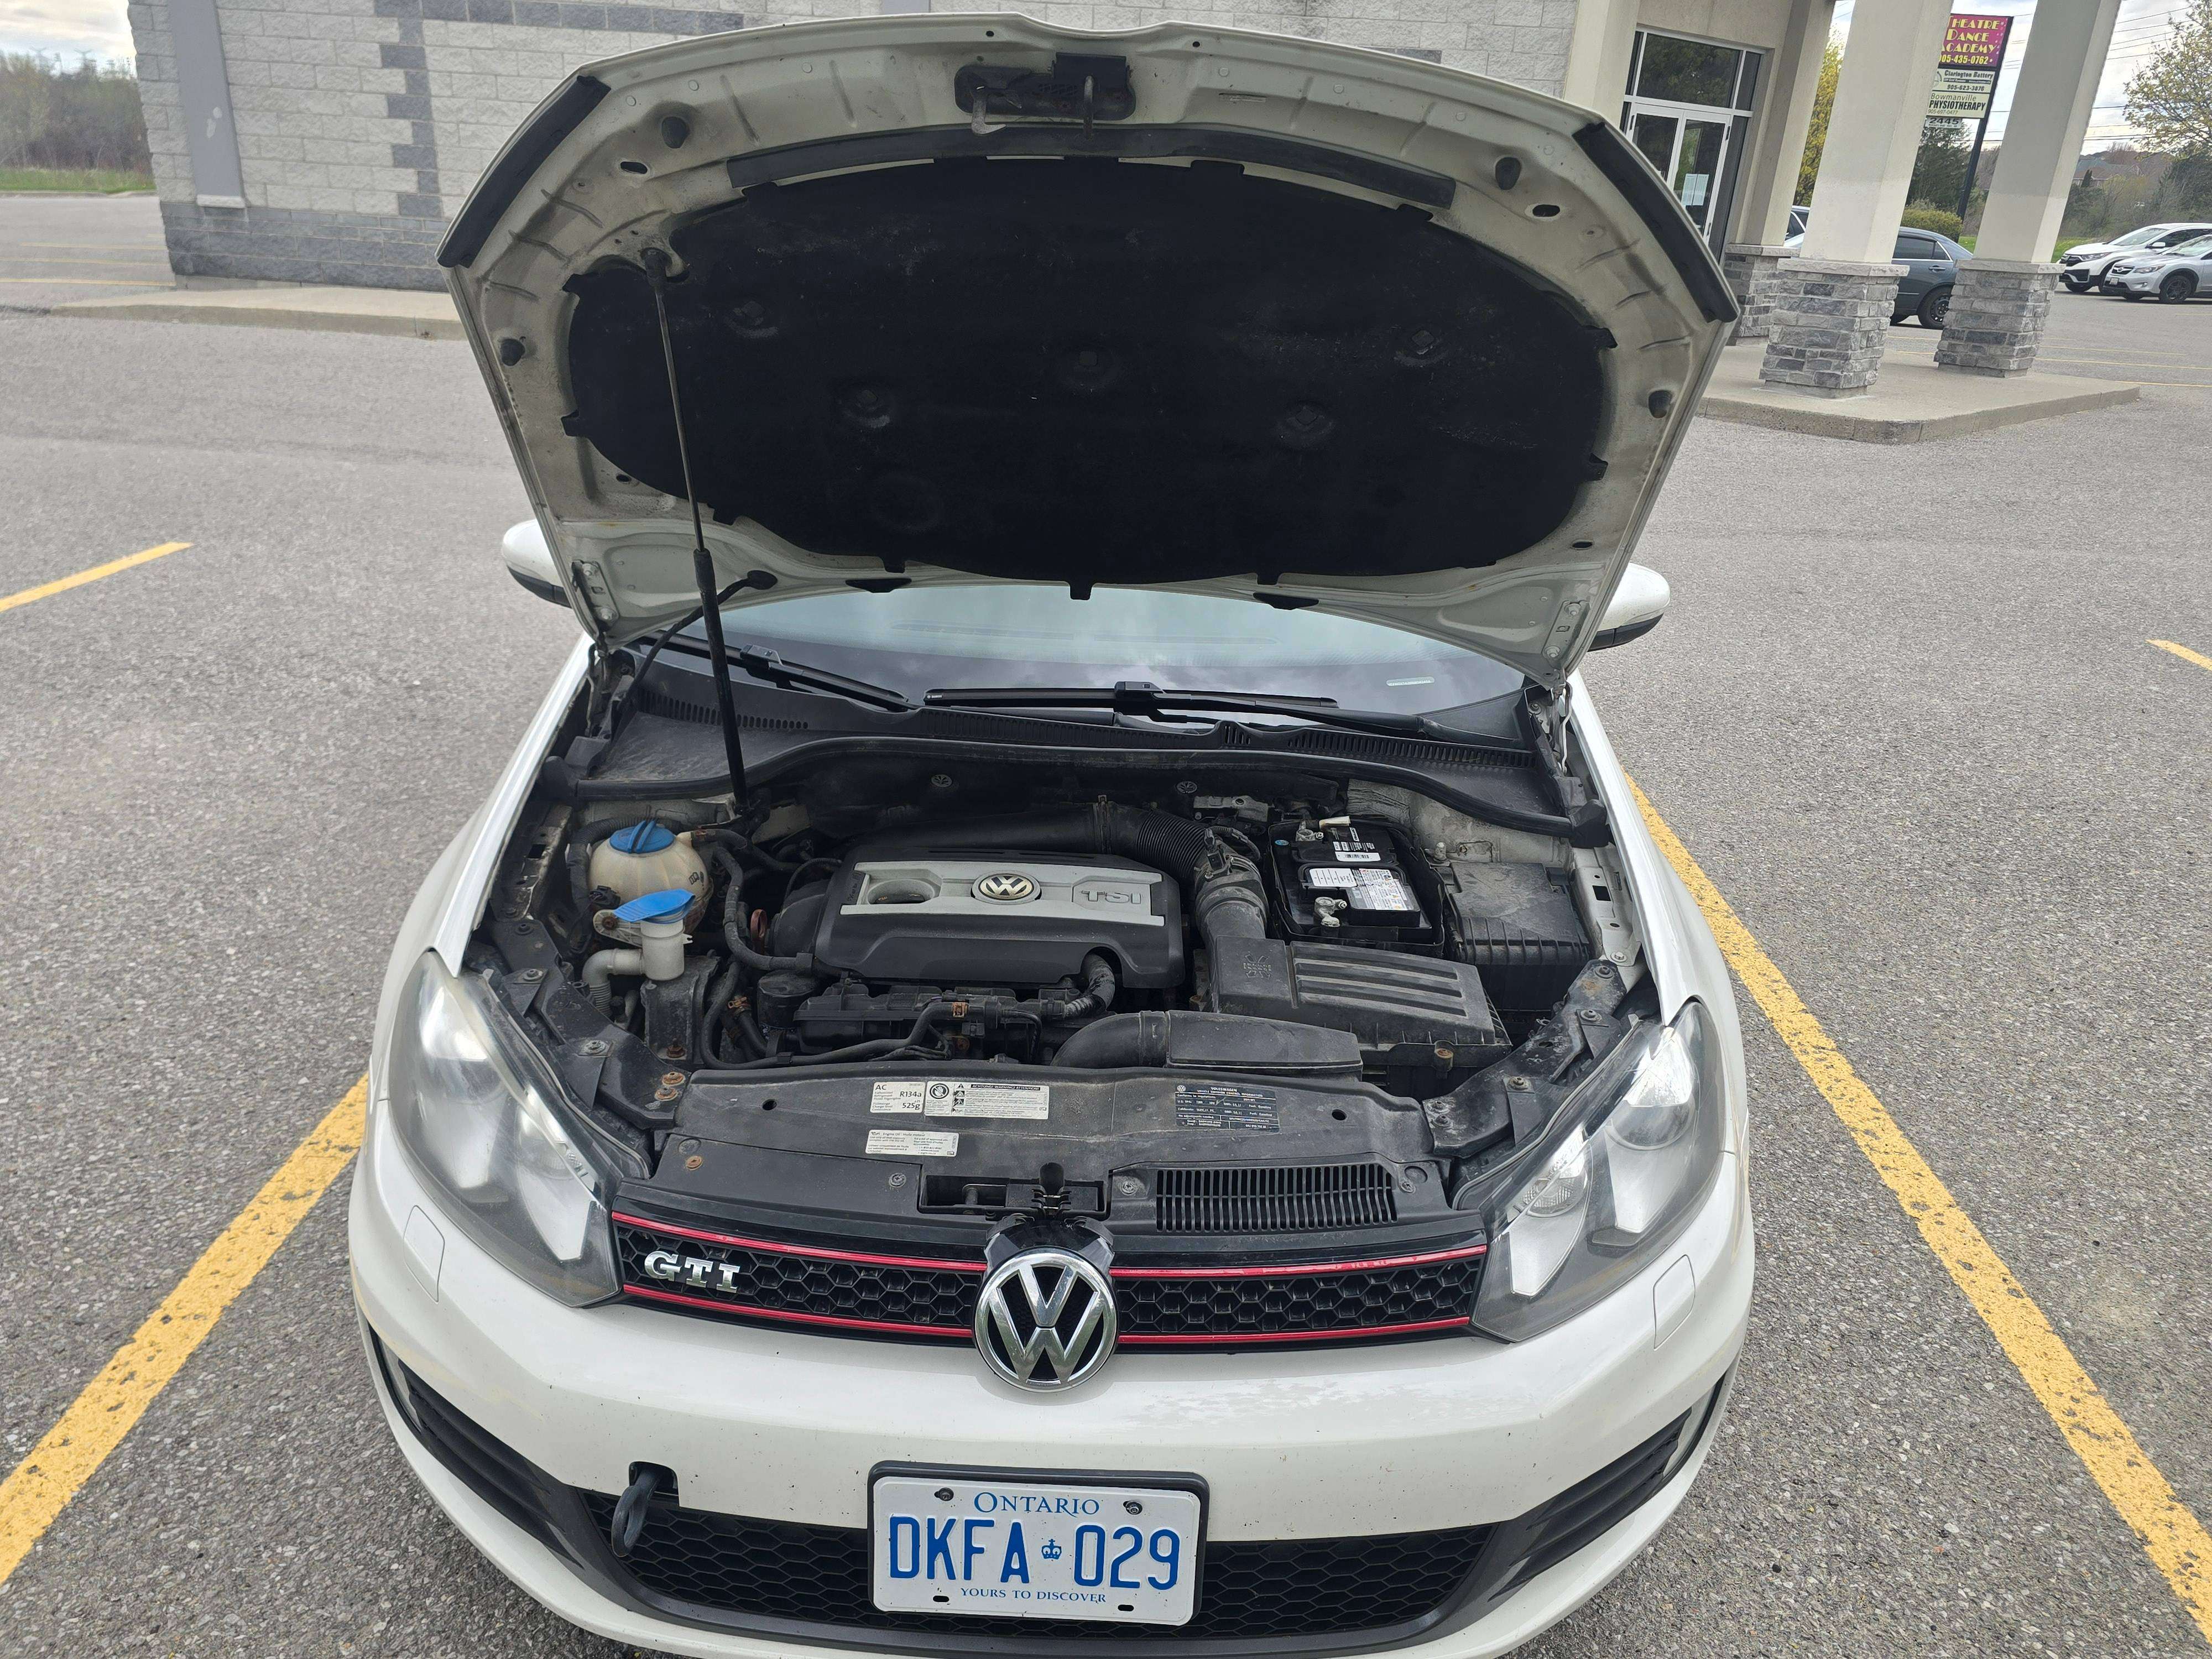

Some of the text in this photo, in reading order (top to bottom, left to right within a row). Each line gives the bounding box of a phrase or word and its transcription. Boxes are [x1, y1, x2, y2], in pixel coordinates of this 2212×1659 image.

[1946, 29, 1989, 42] DANCE
[1944, 70, 1994, 80] Clarington Battery
[1931, 93, 1976, 101] Bowmanville
[1929, 100, 1986, 111] PHYSIOTHERAPY
[1081, 890, 1141, 904] TSI
[644, 1250, 740, 1293] GTI
[974, 1492, 1100, 1518] ONTARIO
[889, 1516, 1181, 1590] DKFA 029
[961, 1588, 1106, 1603] YOURS TO DISCOVER
